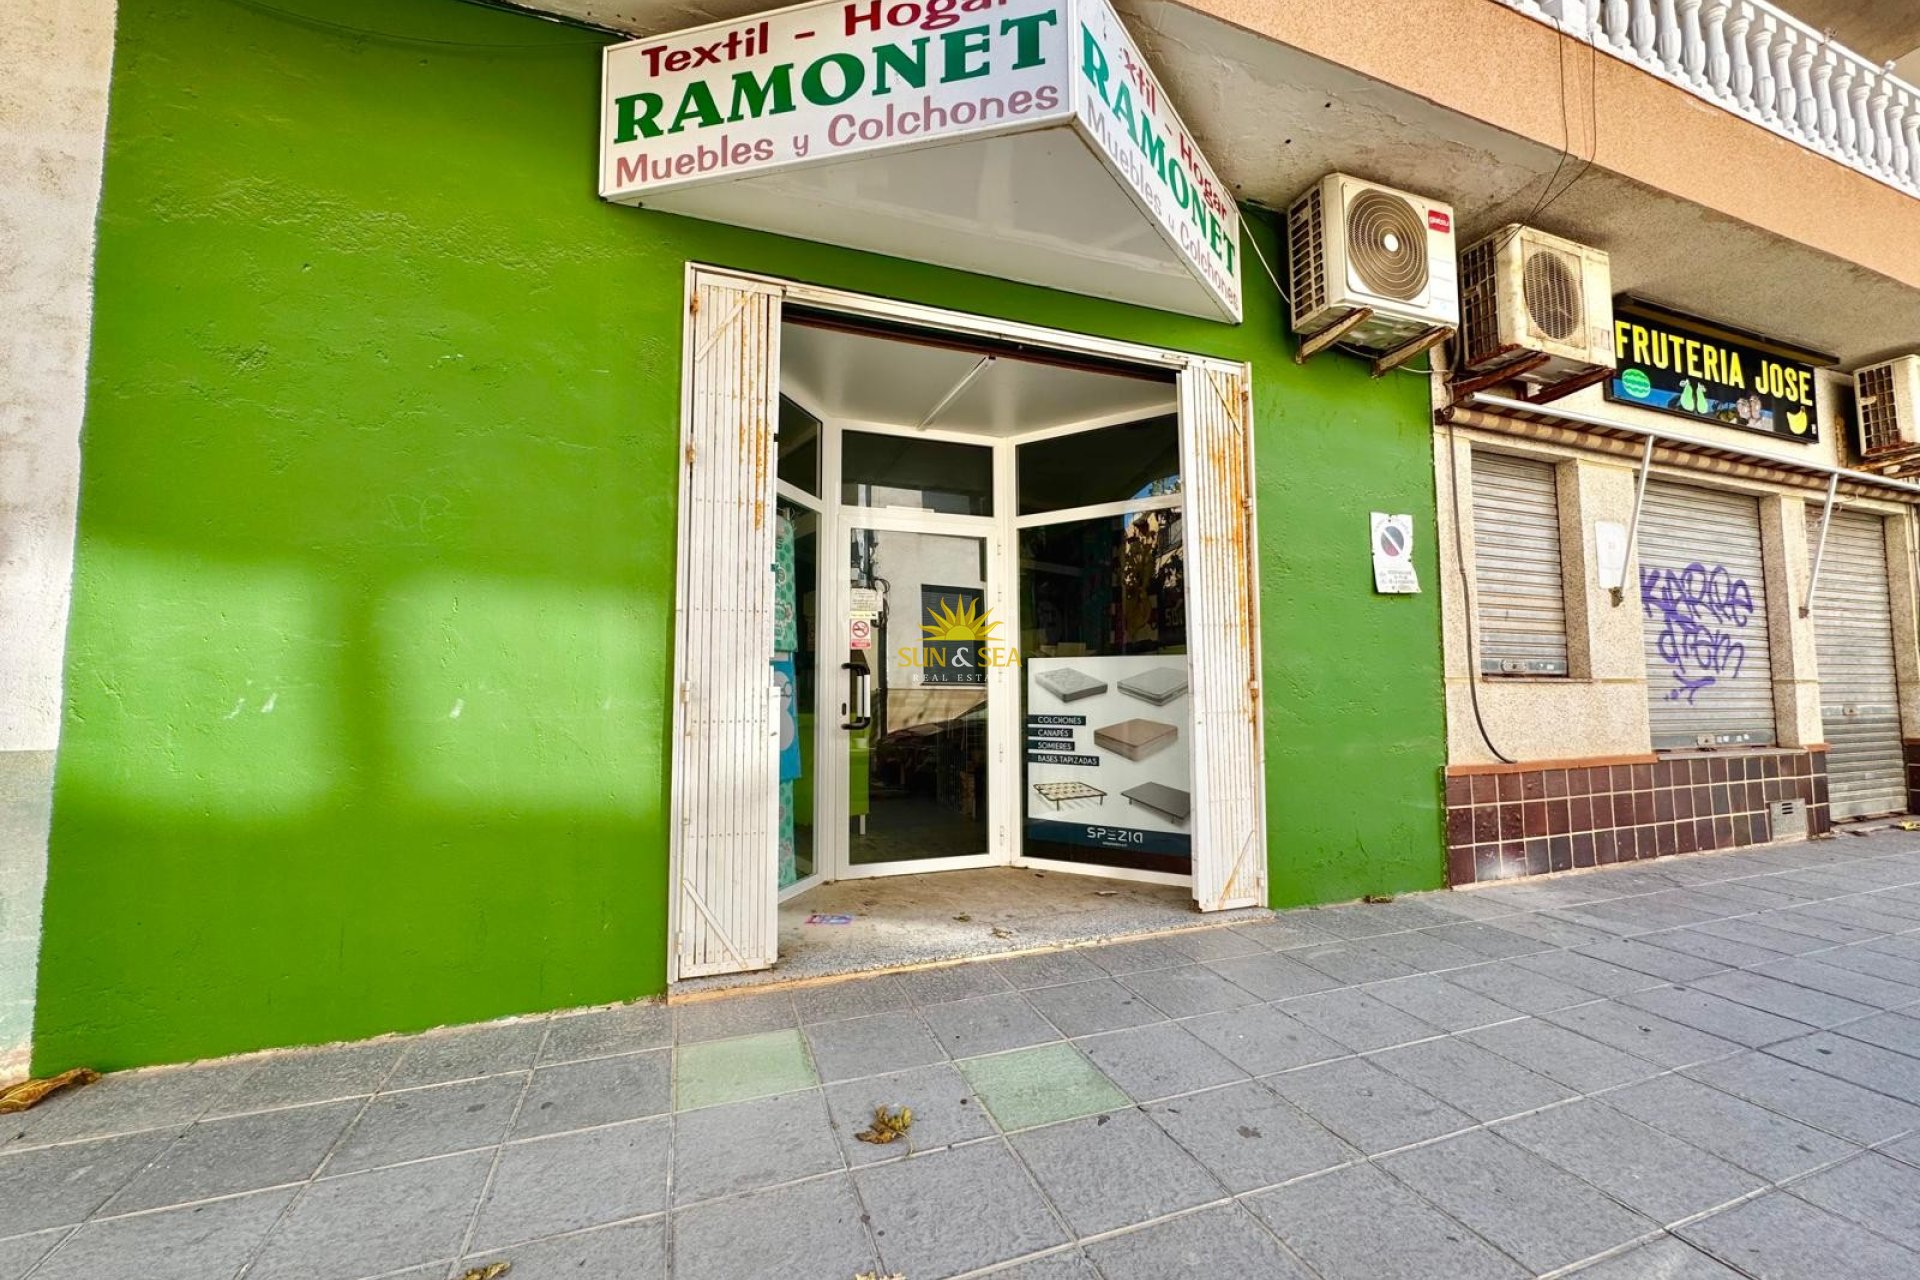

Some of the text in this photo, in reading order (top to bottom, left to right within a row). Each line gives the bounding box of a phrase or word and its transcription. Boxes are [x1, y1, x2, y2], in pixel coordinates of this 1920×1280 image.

[613, 9, 1057, 145] RAMONET
[641, 22, 769, 77] Textil
[844, 0, 1008, 36] Hoga
[616, 85, 1059, 188] Muebles y Colchones
[1079, 20, 1237, 278] RAMONET
[1178, 131, 1228, 221] Hogar
[1086, 93, 1164, 218] Muebles
[1180, 221, 1239, 312] Colchones
[1614, 319, 1813, 406] FRUTERIA JOSE
[1037, 716, 1083, 725] COLCHONES
